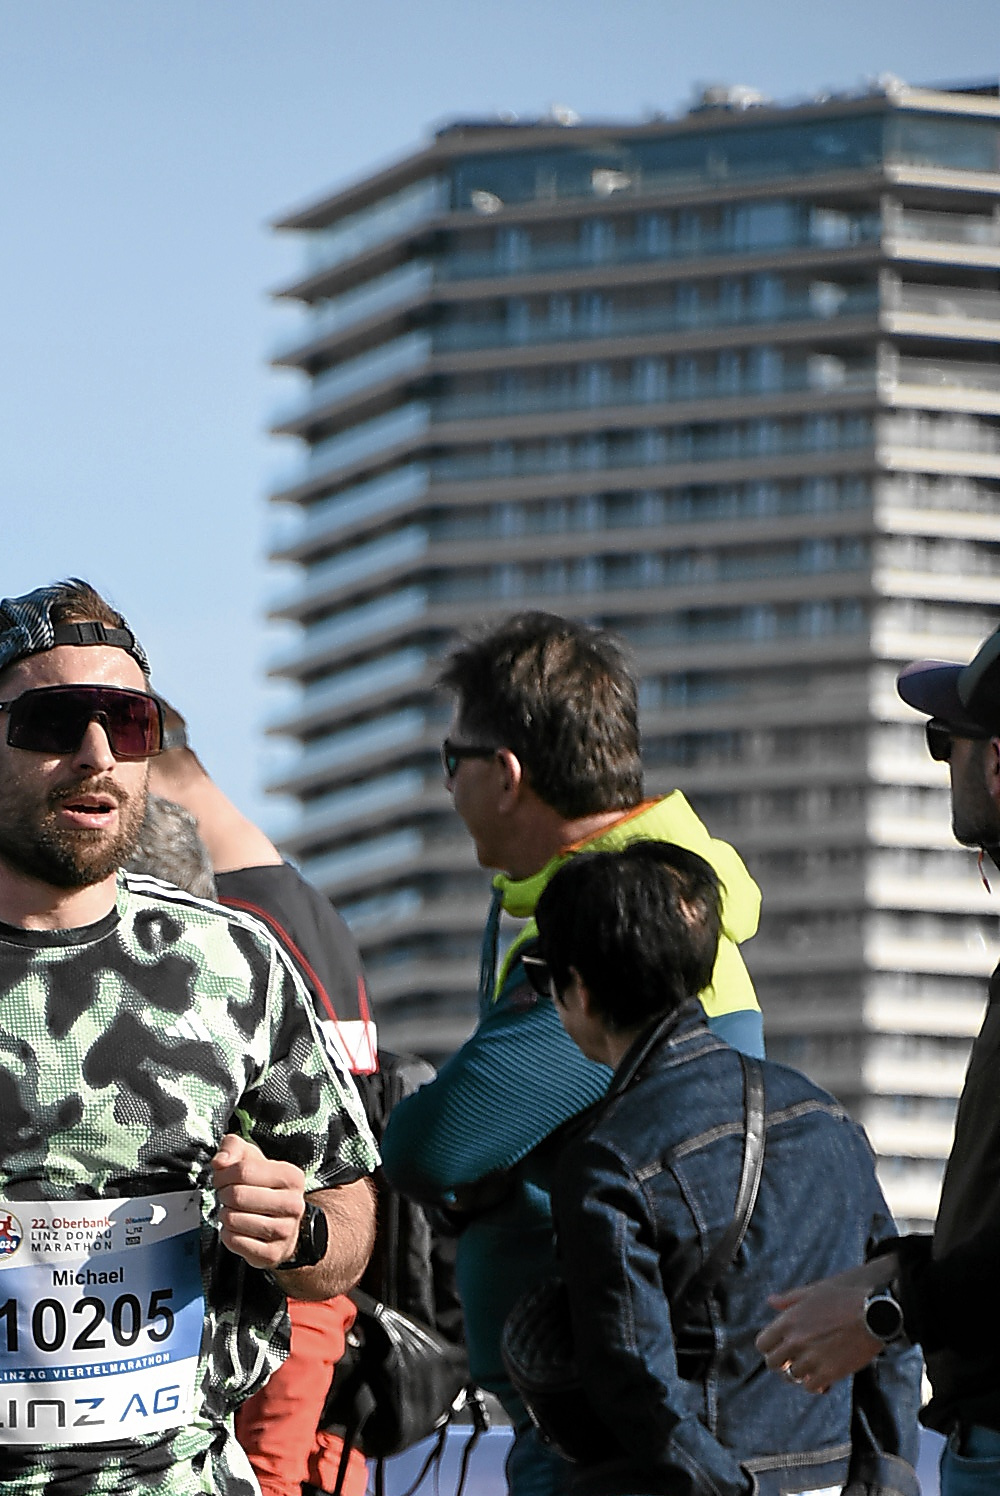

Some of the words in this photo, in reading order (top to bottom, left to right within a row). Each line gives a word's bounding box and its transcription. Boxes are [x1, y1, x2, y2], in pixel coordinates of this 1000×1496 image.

[31, 1218, 50, 1230] 22.
[51, 1217, 111, 1229] Oberbank
[31, 1231, 59, 1241] LINZ
[66, 1229, 112, 1240] DONAU
[31, 1241, 112, 1252] MARATHON
[53, 1267, 124, 1286] Michael
[53, 1353, 170, 1379] VIERTELMARATHON
[119, 1384, 180, 1422] AG
